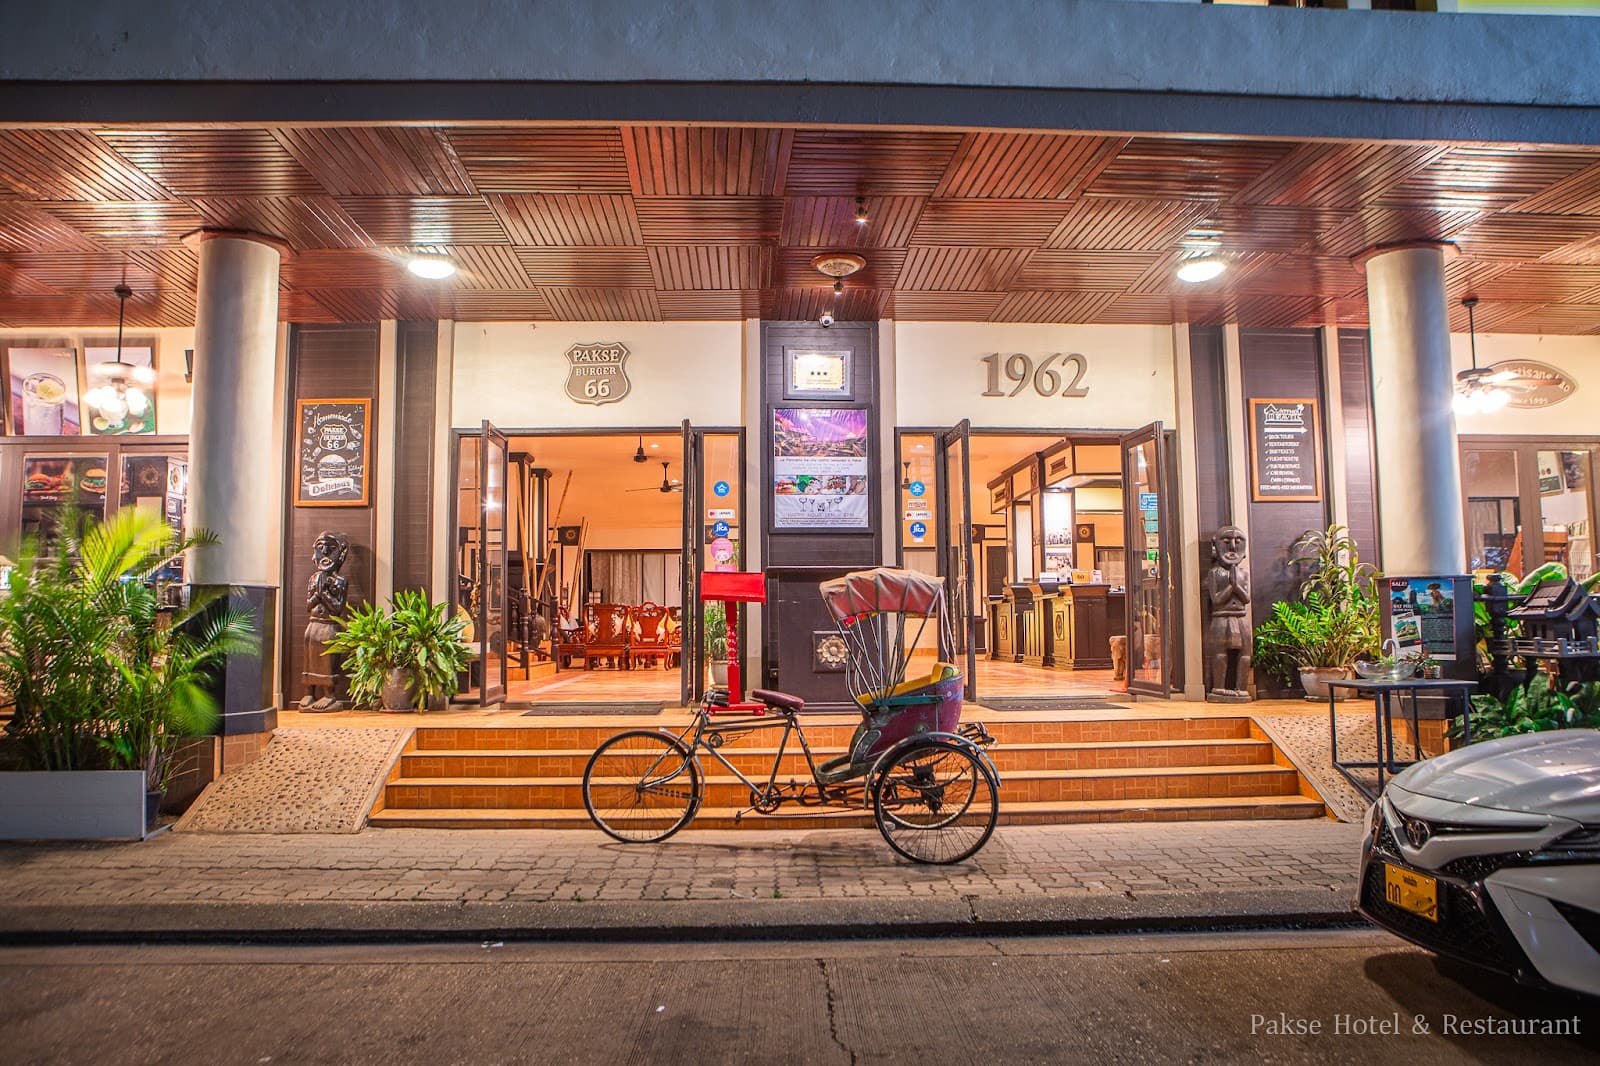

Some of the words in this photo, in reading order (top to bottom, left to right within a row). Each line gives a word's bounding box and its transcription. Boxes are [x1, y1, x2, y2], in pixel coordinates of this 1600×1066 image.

[573, 349, 620, 362] PAKSE
[575, 366, 617, 376] BURGER
[981, 352, 1090, 398] 1962
[584, 379, 611, 398] 66
[312, 412, 353, 428] Homemade
[327, 440, 340, 449] 66
[312, 481, 351, 494] Delicious
